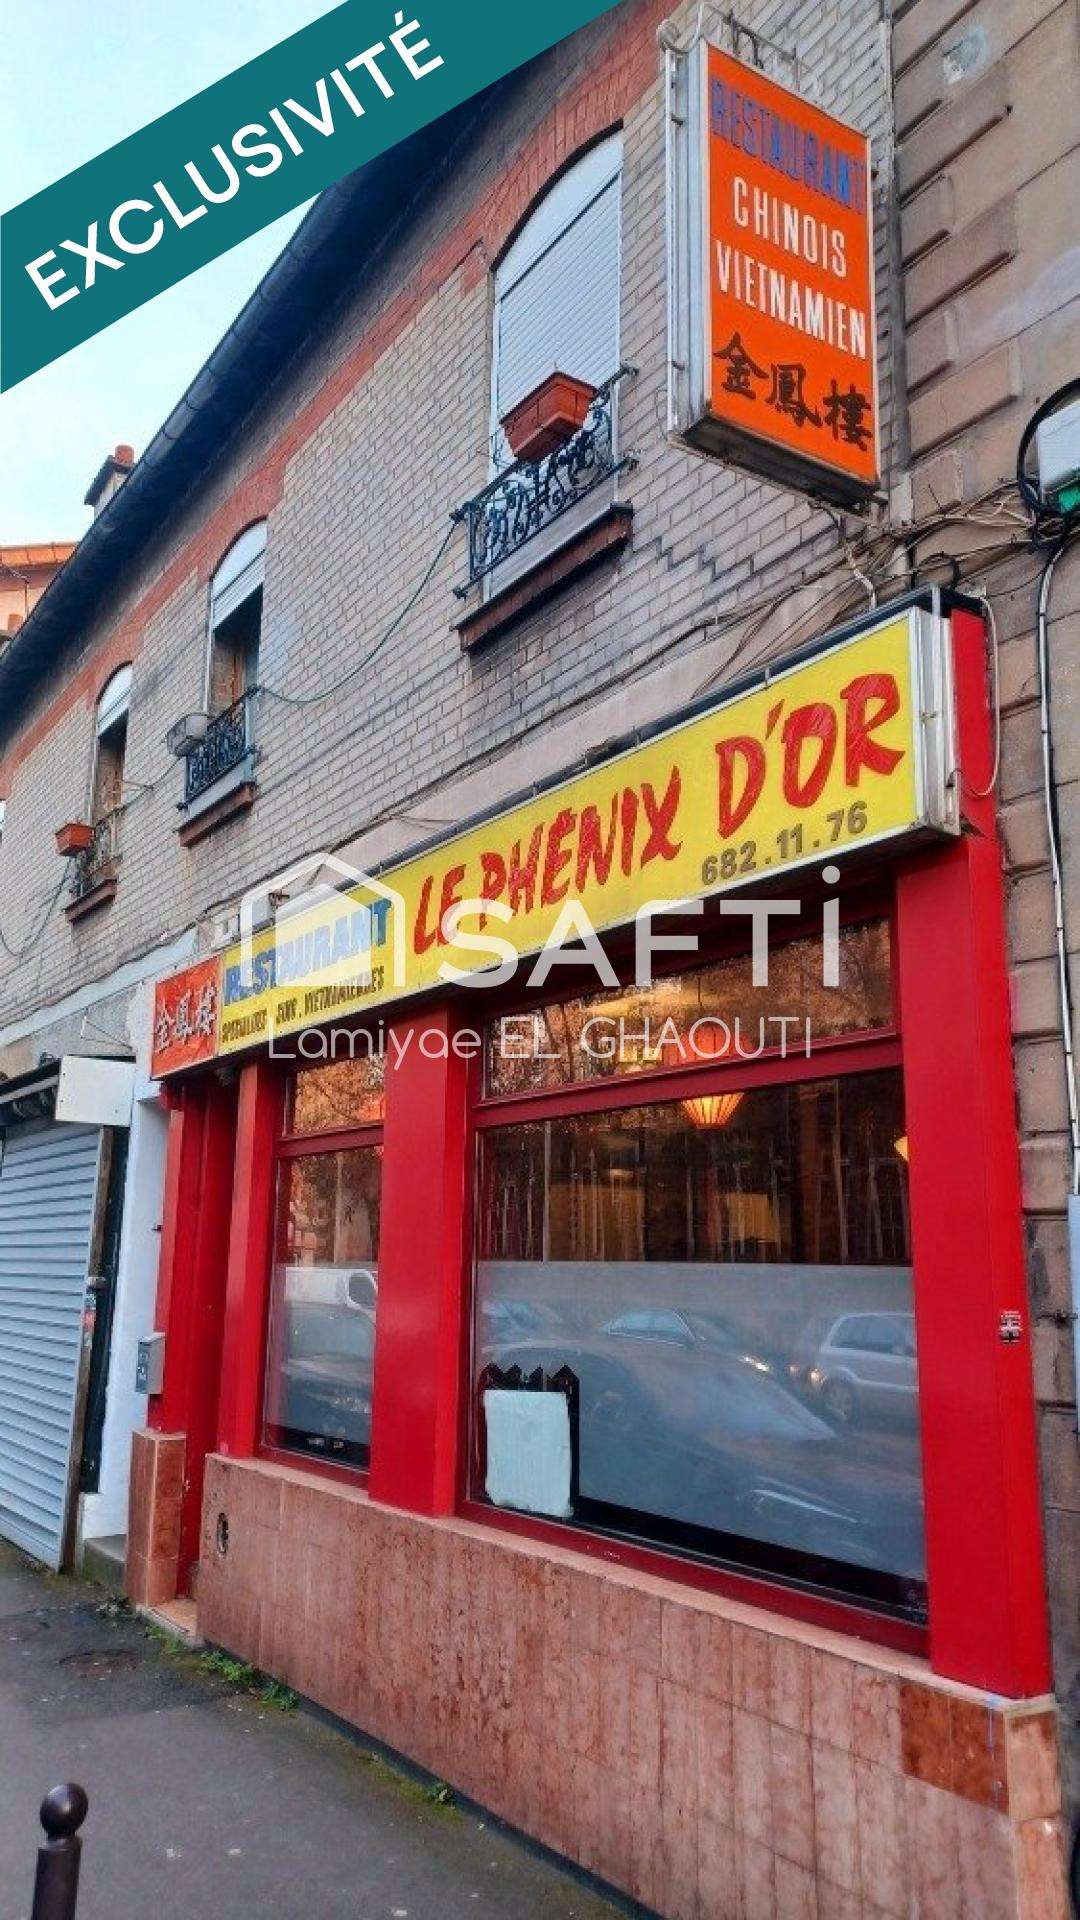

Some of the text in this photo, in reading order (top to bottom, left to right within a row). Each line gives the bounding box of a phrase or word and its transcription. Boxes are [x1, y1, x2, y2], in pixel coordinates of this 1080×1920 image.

[711, 77, 867, 216] RESTAURANT
[733, 176, 848, 279] CHINOIS
[715, 239, 866, 360] VIETNAMIEN
[712, 331, 873, 452] 金鳳樓
[413, 863, 467, 955] LE
[715, 673, 905, 839] D'OR
